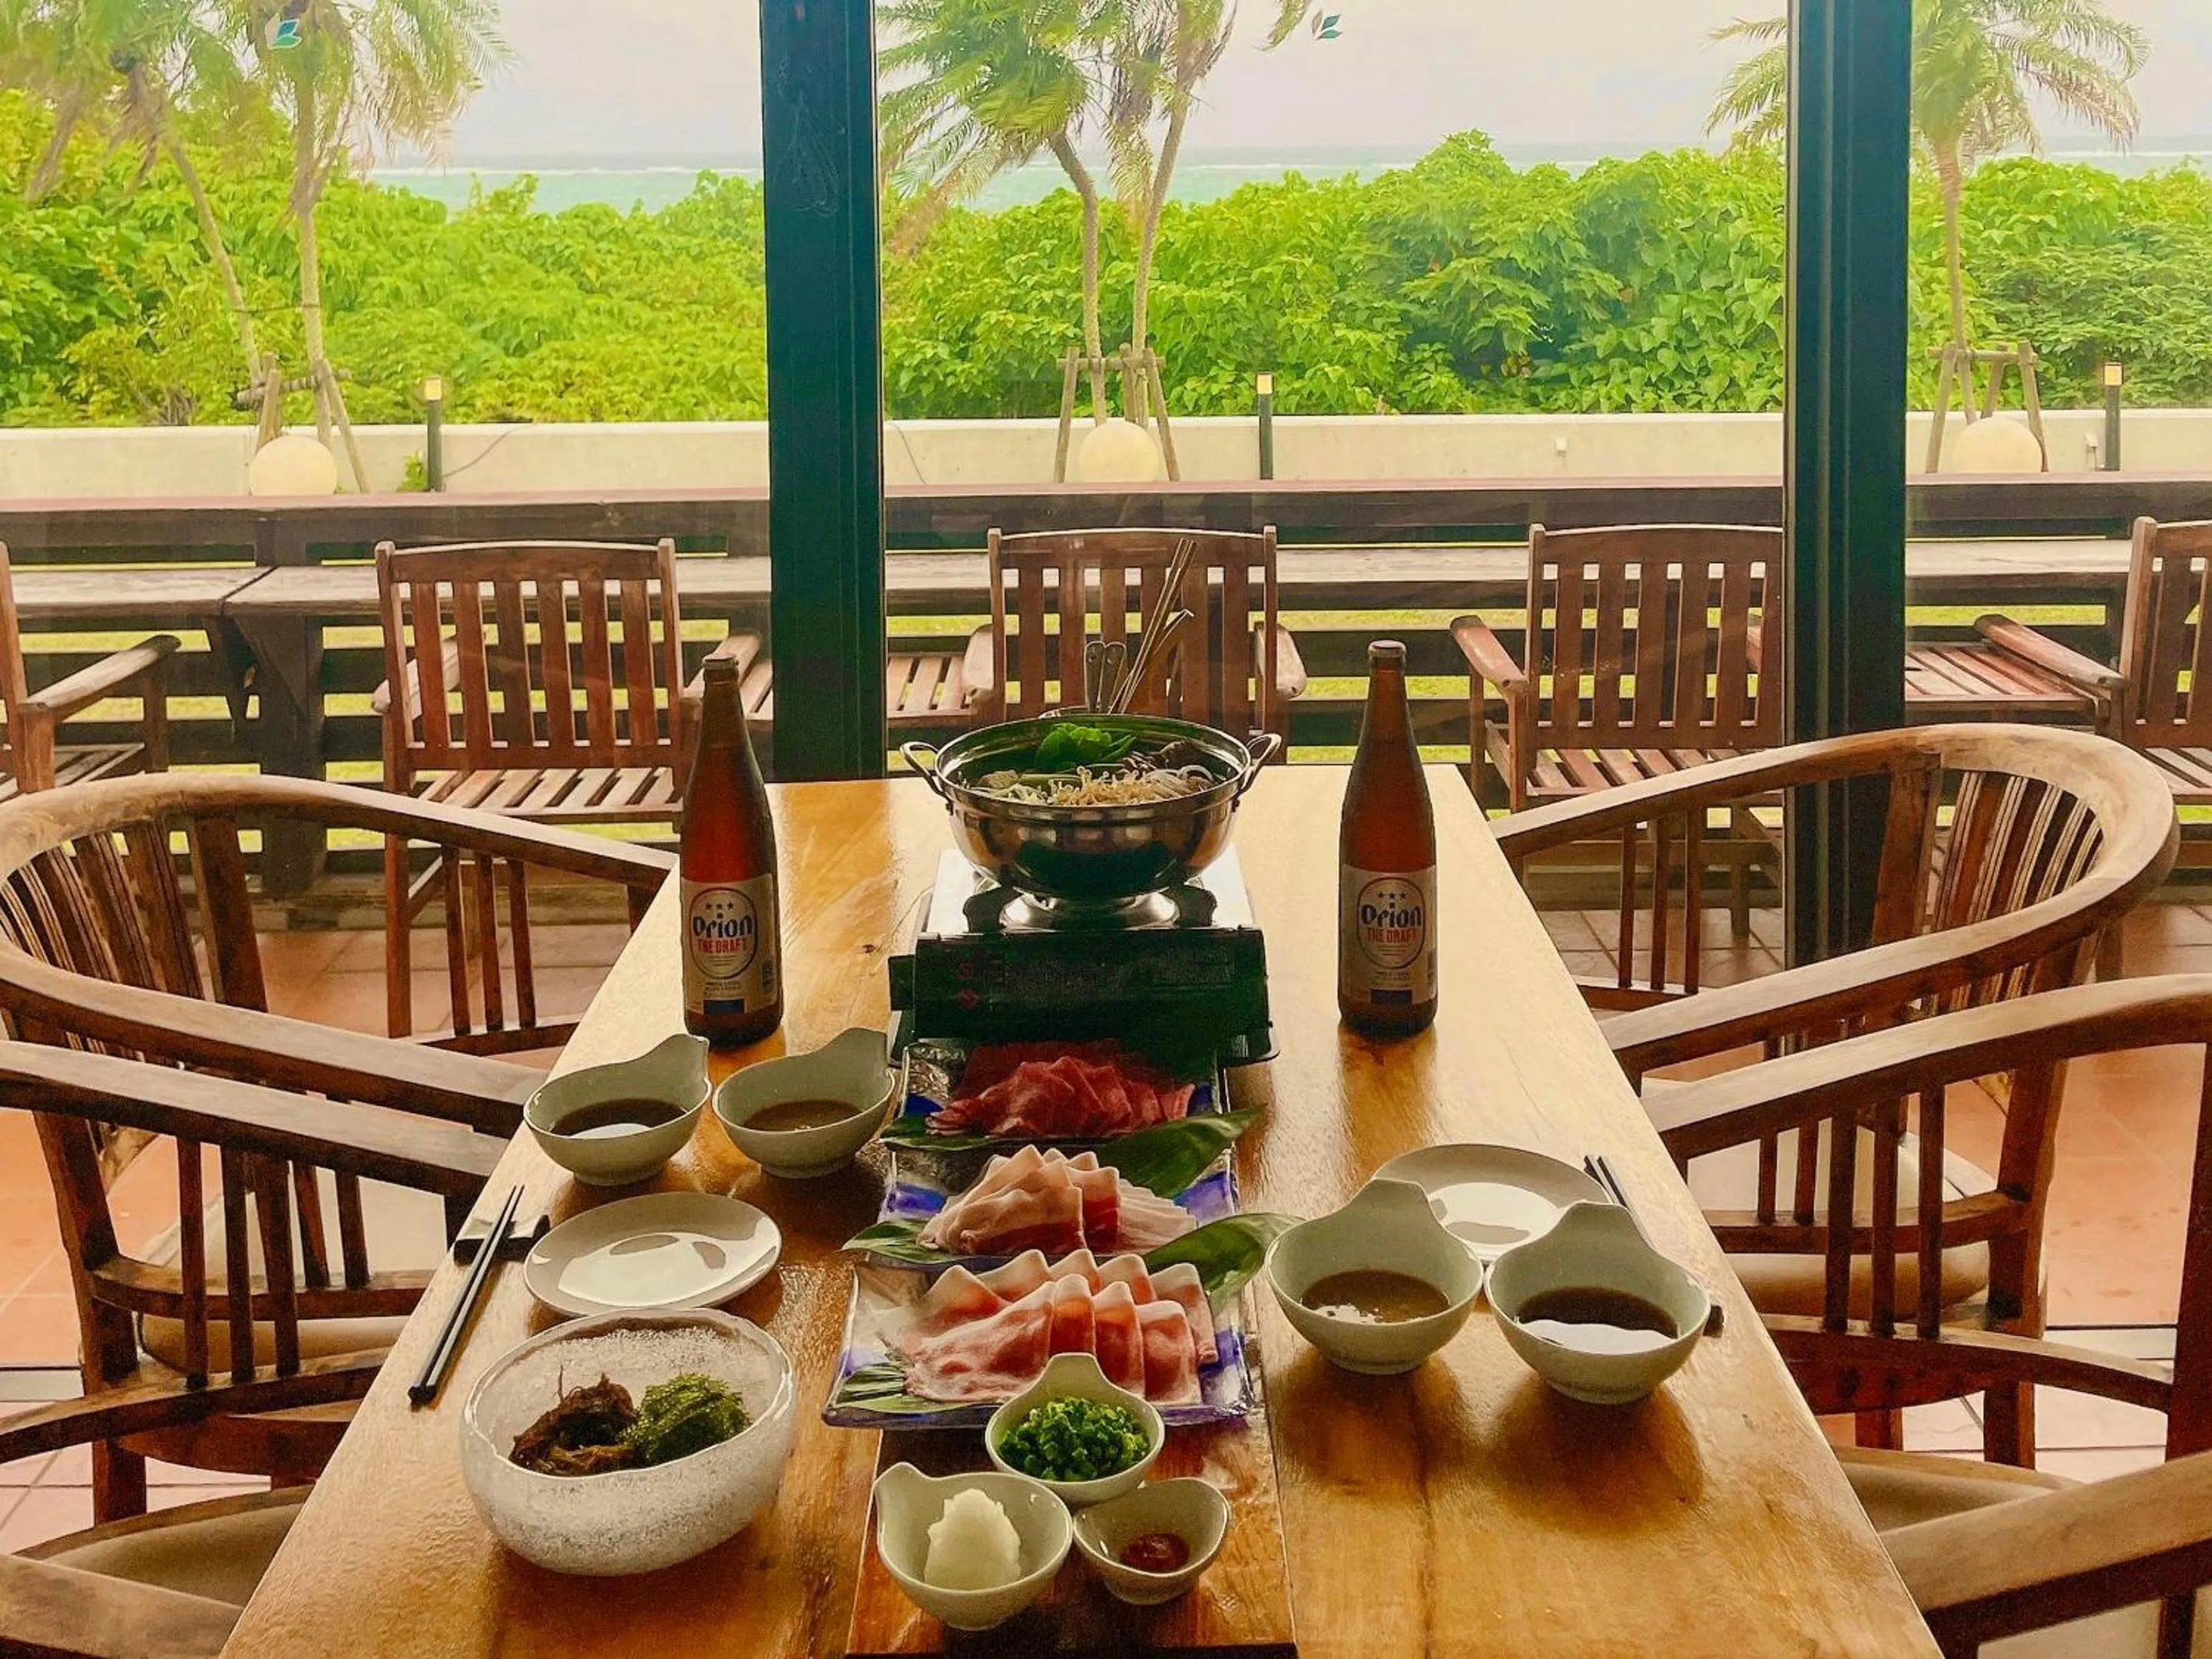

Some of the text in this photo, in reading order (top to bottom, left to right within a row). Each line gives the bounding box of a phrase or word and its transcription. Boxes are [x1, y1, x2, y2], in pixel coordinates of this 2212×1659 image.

[693, 912, 752, 938] Orion
[1361, 902, 1421, 928] Orion
[697, 938, 747, 953] THE DRAFT
[1367, 928, 1416, 943] THE DRAFT
